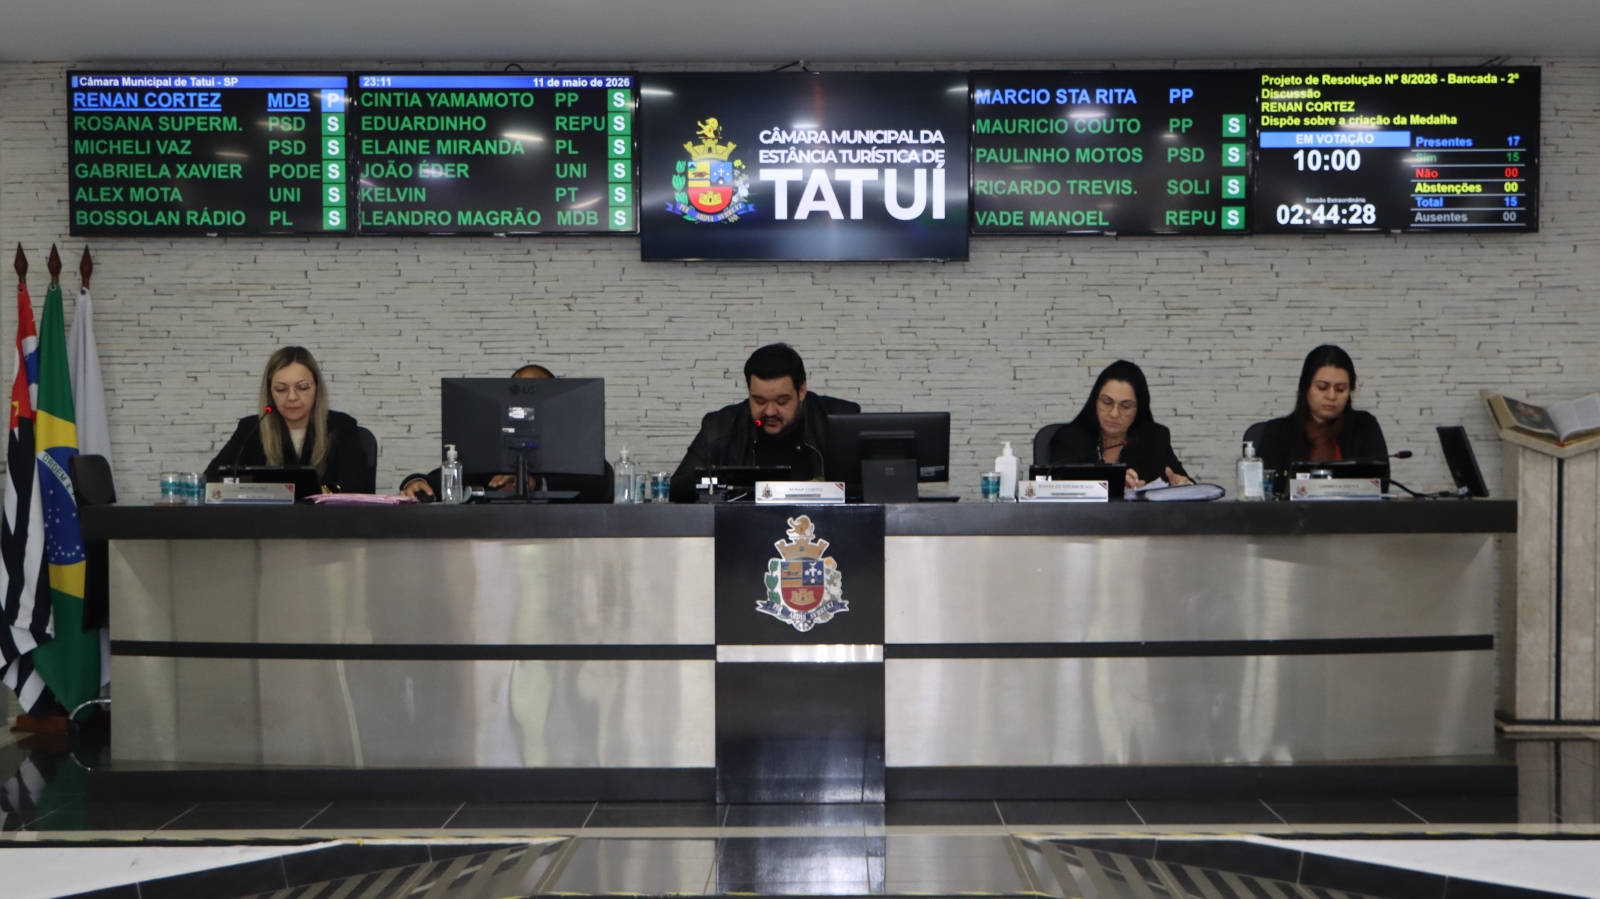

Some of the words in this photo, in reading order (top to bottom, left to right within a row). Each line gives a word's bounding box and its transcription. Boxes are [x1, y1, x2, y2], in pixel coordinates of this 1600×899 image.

[80, 77, 119, 86] Câmara
[122, 77, 171, 88] Municipal
[174, 78, 187, 86] de
[224, 78, 238, 86] SP
[364, 77, 391, 87] 23:11
[533, 78, 544, 87] 11
[547, 78, 560, 87] de
[562, 78, 588, 87] maio
[591, 78, 603, 87] de
[606, 78, 630, 87] 2026
[1262, 75, 1302, 88] Projeto
[1305, 75, 1319, 85] de
[1322, 75, 1381, 87] Resolução
[1401, 74, 1437, 85] 8/2026
[1448, 74, 1498, 84] Bancada
[73, 93, 138, 108] RENAN
[144, 92, 221, 108] CORTEZ
[268, 93, 310, 107] MDB
[327, 93, 339, 107] P
[361, 93, 422, 107] CINTIA
[427, 93, 534, 107] YAMAMOTO
[555, 93, 579, 107] PP
[613, 93, 625, 108] S
[976, 89, 1050, 104] MARCIO
[1056, 89, 1091, 104] STA
[1096, 89, 1137, 104] RITA
[1169, 89, 1193, 103] PP
[1262, 89, 1321, 99] Discussão
[1261, 102, 1302, 112] RENAN
[1306, 101, 1355, 112] CORTEZ
[74, 117, 153, 131] ROSANA
[158, 117, 242, 132] SUPERM.
[268, 117, 305, 131] PSD
[327, 117, 339, 131] S
[362, 116, 486, 131] EDUARDINHO
[556, 117, 605, 131] REPU
[613, 117, 625, 131] S
[976, 119, 1068, 134] MAURICIO
[1074, 118, 1141, 134] COUTO
[1169, 118, 1193, 133] PP
[1228, 118, 1240, 133] S
[1261, 116, 1300, 127] Dispõe
[1303, 115, 1336, 126] sobre
[1348, 115, 1389, 126] criação
[1393, 115, 1407, 125] da
[1410, 115, 1457, 125] Medalha
[759, 127, 830, 144] CÂMARA
[831, 130, 919, 144] MUNICIPAL
[920, 130, 945, 144] DA
[1296, 135, 1313, 144] EM
[1316, 134, 1374, 146] VOTAÇÃO
[1415, 136, 1473, 147] Presentes
[1507, 136, 1520, 146] 17
[75, 140, 150, 155] MICHELI
[157, 140, 191, 155] VAZ
[269, 140, 306, 155] PSD
[328, 141, 339, 155] S
[362, 140, 430, 154] ELAINE
[437, 140, 524, 154] MIRANDA
[556, 140, 578, 154] PL
[613, 140, 625, 155] S
[759, 147, 837, 164] ESTÂNCIA
[839, 146, 921, 164] TURÍSTICA
[923, 150, 945, 164] DE
[976, 148, 1069, 163] PAULINHO
[1076, 148, 1143, 163] MOTOS
[1167, 148, 1205, 162] PSD
[1228, 148, 1240, 162] S
[1293, 150, 1361, 171] 10:00
[1416, 153, 1437, 162] Sim
[1506, 152, 1519, 161] 15
[75, 164, 171, 178] GABRIELA
[176, 164, 242, 178] XAVIER
[269, 164, 320, 179] PODE
[328, 164, 340, 179] S
[361, 161, 413, 178] JOÃO
[419, 160, 469, 178] ÉDER
[556, 164, 587, 178] UNI
[614, 164, 626, 179] S
[1415, 168, 1439, 178] Não
[1505, 168, 1518, 177] 00
[75, 187, 124, 202] ALEX
[130, 187, 183, 202] MOTA
[270, 188, 300, 202] UNI
[328, 188, 340, 202] S
[361, 188, 426, 202] KELVIN
[556, 188, 578, 202] PT
[614, 188, 626, 202] S
[760, 161, 946, 220] TATUÍ
[976, 180, 1060, 195] RICARDO
[1067, 180, 1137, 195] TREVIS.
[1167, 180, 1209, 195] SOLI
[1228, 180, 1240, 194] S
[1415, 183, 1482, 194] Abstenções
[1504, 182, 1518, 192] 00
[1415, 197, 1443, 207] Total
[1504, 197, 1518, 206] 15
[76, 211, 180, 226] BOSSOLAN
[187, 207, 246, 226] RÁDIO
[270, 211, 292, 225] PL
[329, 212, 340, 226] S
[361, 211, 451, 225] LEANDRO
[458, 207, 541, 226] MAGRÃO
[558, 211, 599, 225] MDB
[614, 211, 626, 225] S
[975, 211, 1023, 225] VADE
[1030, 211, 1109, 226] MANOEL
[1166, 210, 1215, 225] REPU
[1227, 210, 1239, 225] S
[1276, 204, 1376, 225] 02:44:28
[1415, 213, 1467, 222] Ausentes
[1503, 212, 1516, 221] 00
[523, 386, 535, 394] LG
[42, 454, 67, 481] ORDEM
